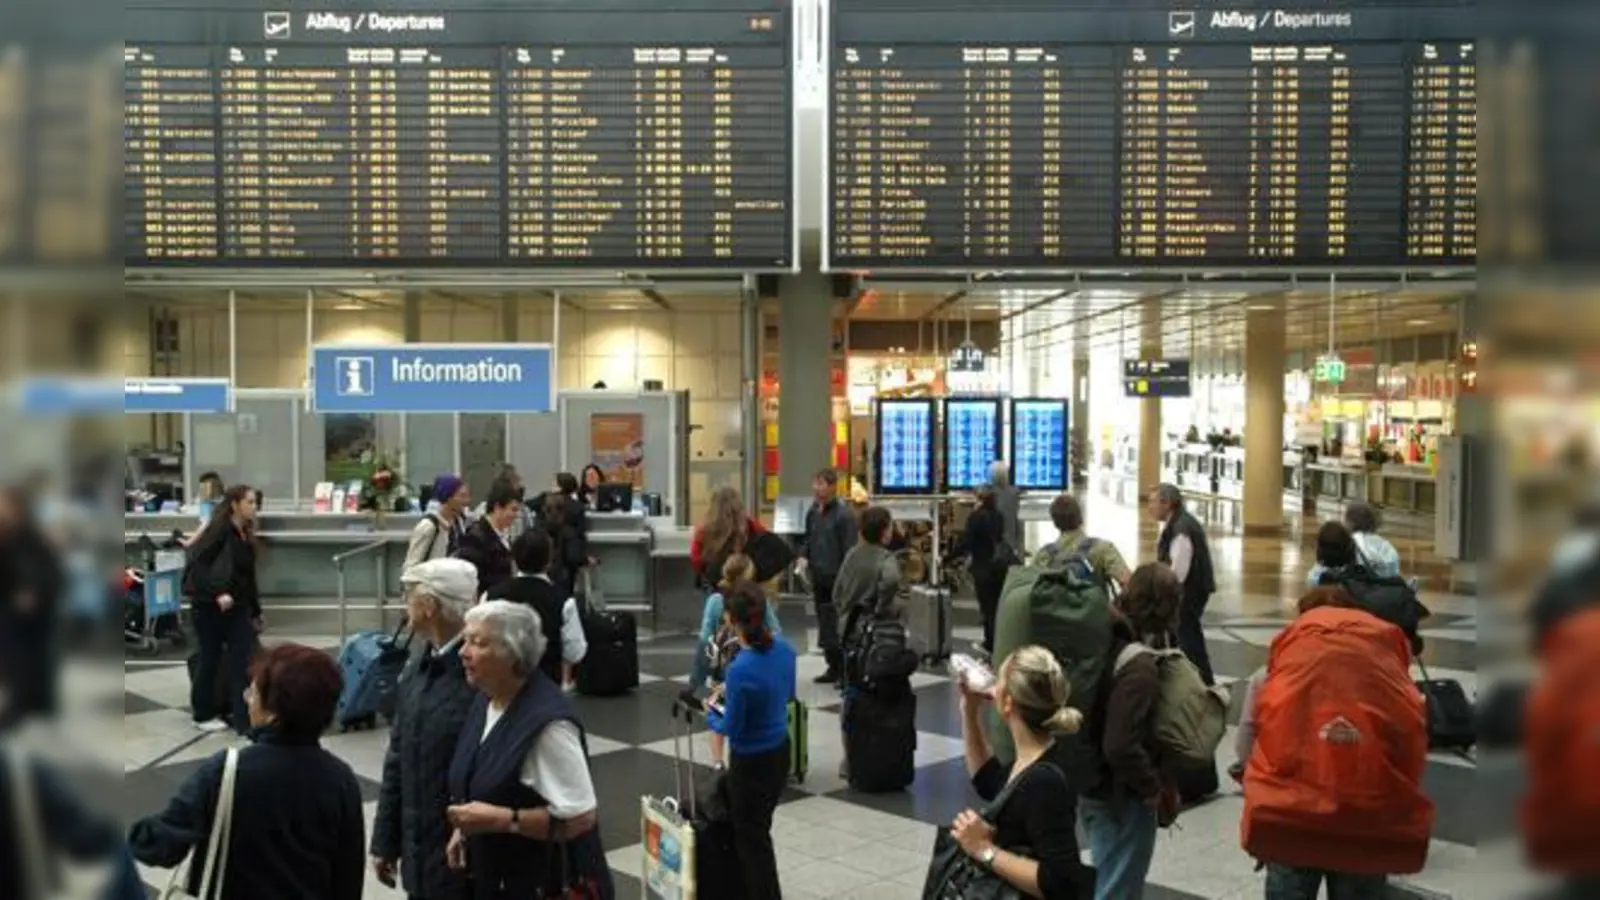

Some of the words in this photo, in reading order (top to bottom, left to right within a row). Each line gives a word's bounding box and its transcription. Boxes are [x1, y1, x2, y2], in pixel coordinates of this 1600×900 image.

[305, 12, 351, 33] Abflug
[354, 13, 366, 30] /
[368, 13, 445, 32] Departures
[1210, 11, 1257, 31] Abflug
[1259, 12, 1272, 29] /
[1274, 11, 1351, 30] Departures
[391, 357, 522, 383] Information
